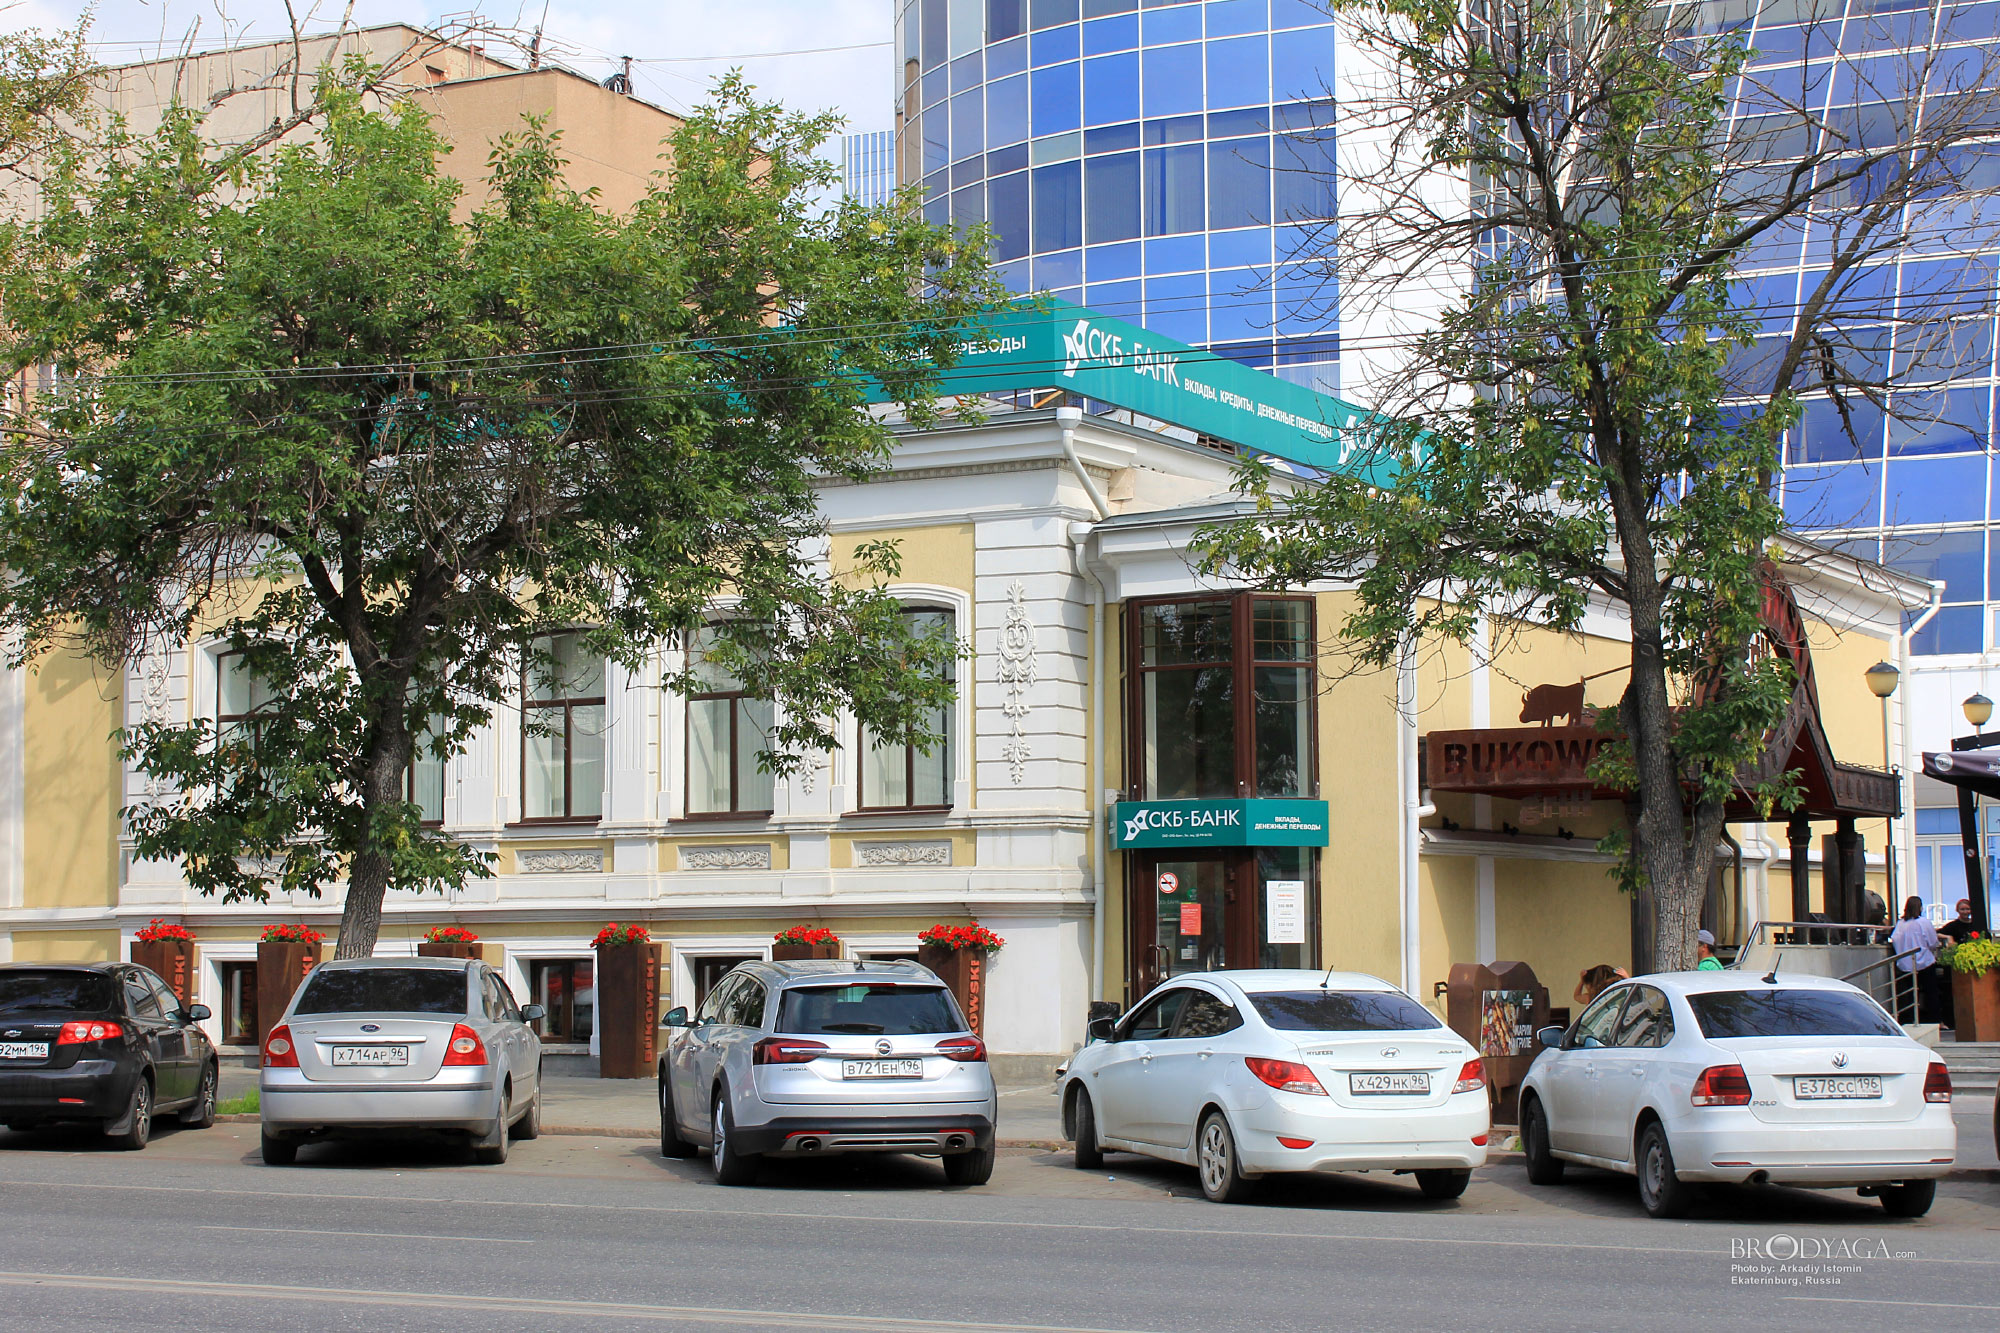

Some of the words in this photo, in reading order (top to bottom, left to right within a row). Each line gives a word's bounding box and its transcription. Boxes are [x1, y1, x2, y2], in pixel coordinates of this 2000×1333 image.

[947, 335, 1026, 356] РЕВОДЫ
[1184, 377, 1217, 403] ВКЛАДЫ,
[1219, 391, 1255, 417] КРЕДИТЫ,
[1257, 404, 1295, 427] ДЕНЕЖНЫЕ
[1296, 413, 1332, 438] ПЕРЕВОДЫ
[1444, 739, 1614, 773] BUKOW
[1148, 809, 1241, 828] СКБ-БАНК
[1254, 823, 1288, 831] ДЕНЕЖНЫЕ
[1288, 823, 1322, 831] ПЕРЕВОДЫ
[29, 1044, 46, 1053] 196
[390, 1047, 404, 1058] 96
[900, 1060, 919, 1071] 196
[1411, 1075, 1425, 1086] 96
[1857, 1077, 1878, 1090] 196
